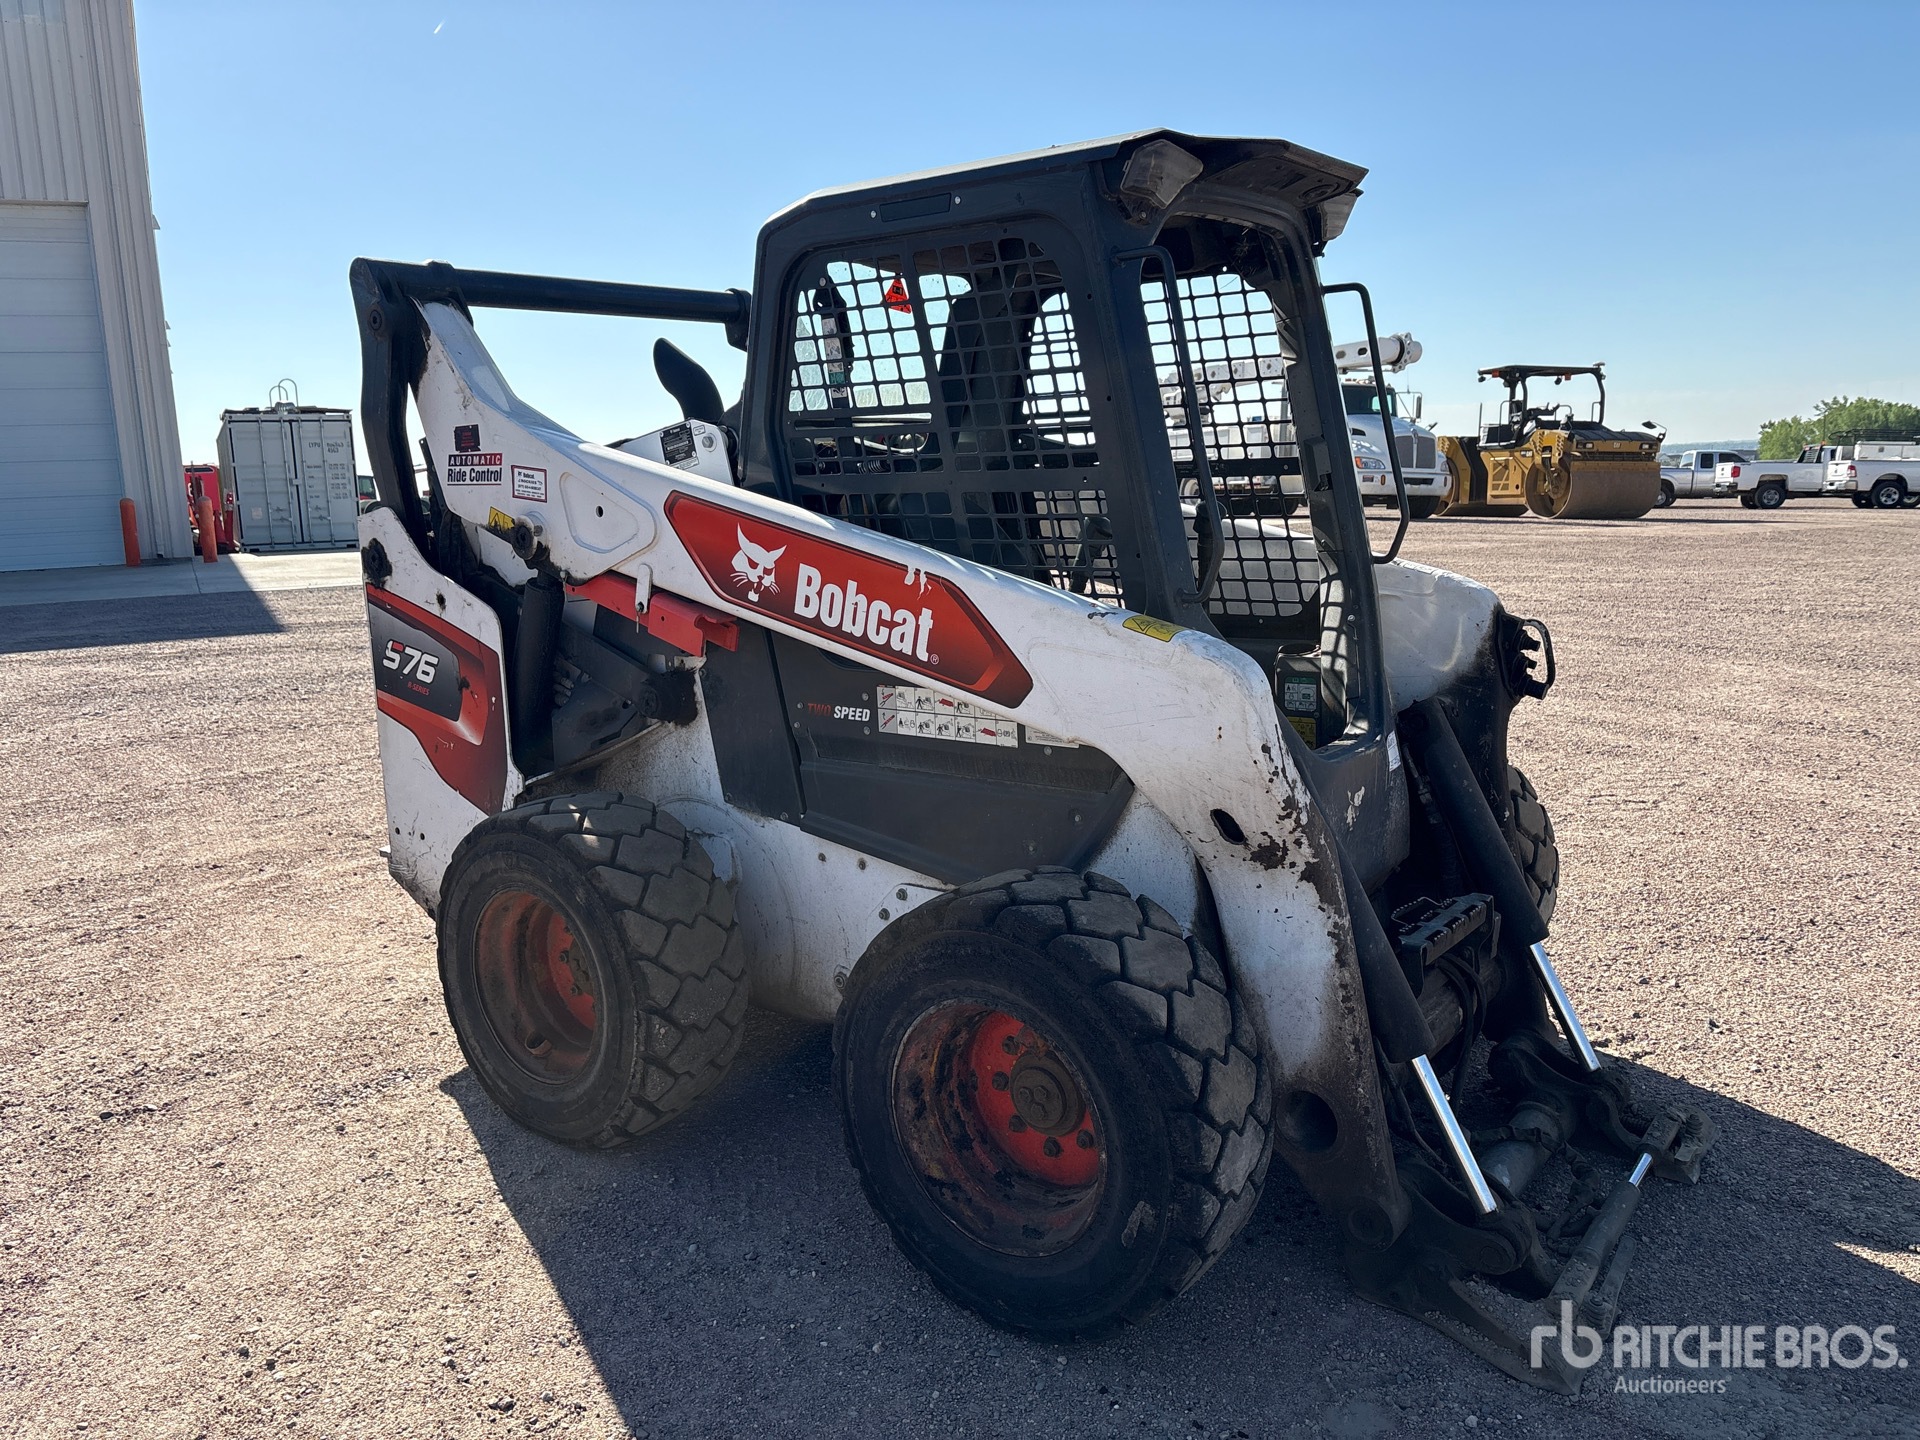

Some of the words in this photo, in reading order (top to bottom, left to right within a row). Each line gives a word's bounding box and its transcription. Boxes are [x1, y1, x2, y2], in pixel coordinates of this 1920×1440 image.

[450, 455, 501, 466] AUTOMATIC
[447, 468, 467, 482] Ride
[469, 467, 503, 482] Control
[794, 562, 934, 662] Bobcat
[382, 640, 439, 684] S76
[807, 703, 832, 717] TWO
[833, 705, 871, 722] SPEED
